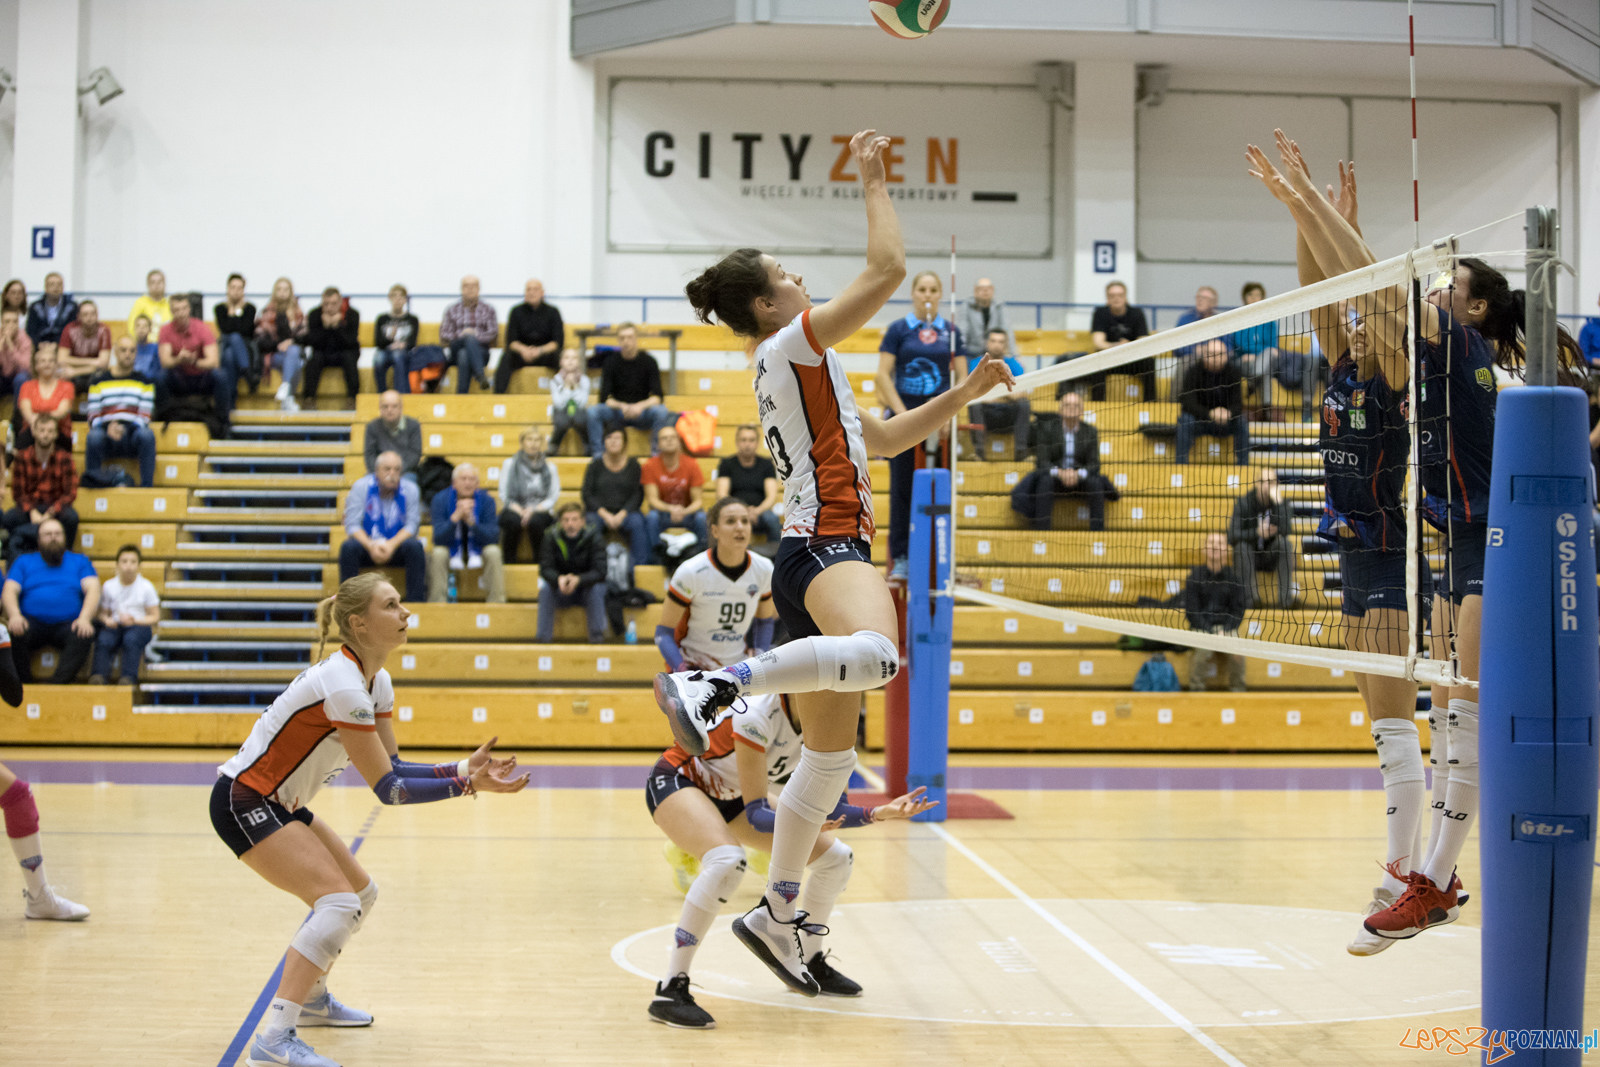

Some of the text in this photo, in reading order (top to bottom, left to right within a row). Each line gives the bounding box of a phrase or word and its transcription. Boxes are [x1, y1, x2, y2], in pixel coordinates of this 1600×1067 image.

[645, 131, 959, 184] CITYZEN
[36, 230, 50, 256] C
[1097, 245, 1113, 269] B
[1558, 541, 1578, 631] Senoh
[718, 602, 746, 623] 99
[768, 756, 789, 776] 5
[655, 775, 666, 789] 5
[241, 808, 268, 826] 16
